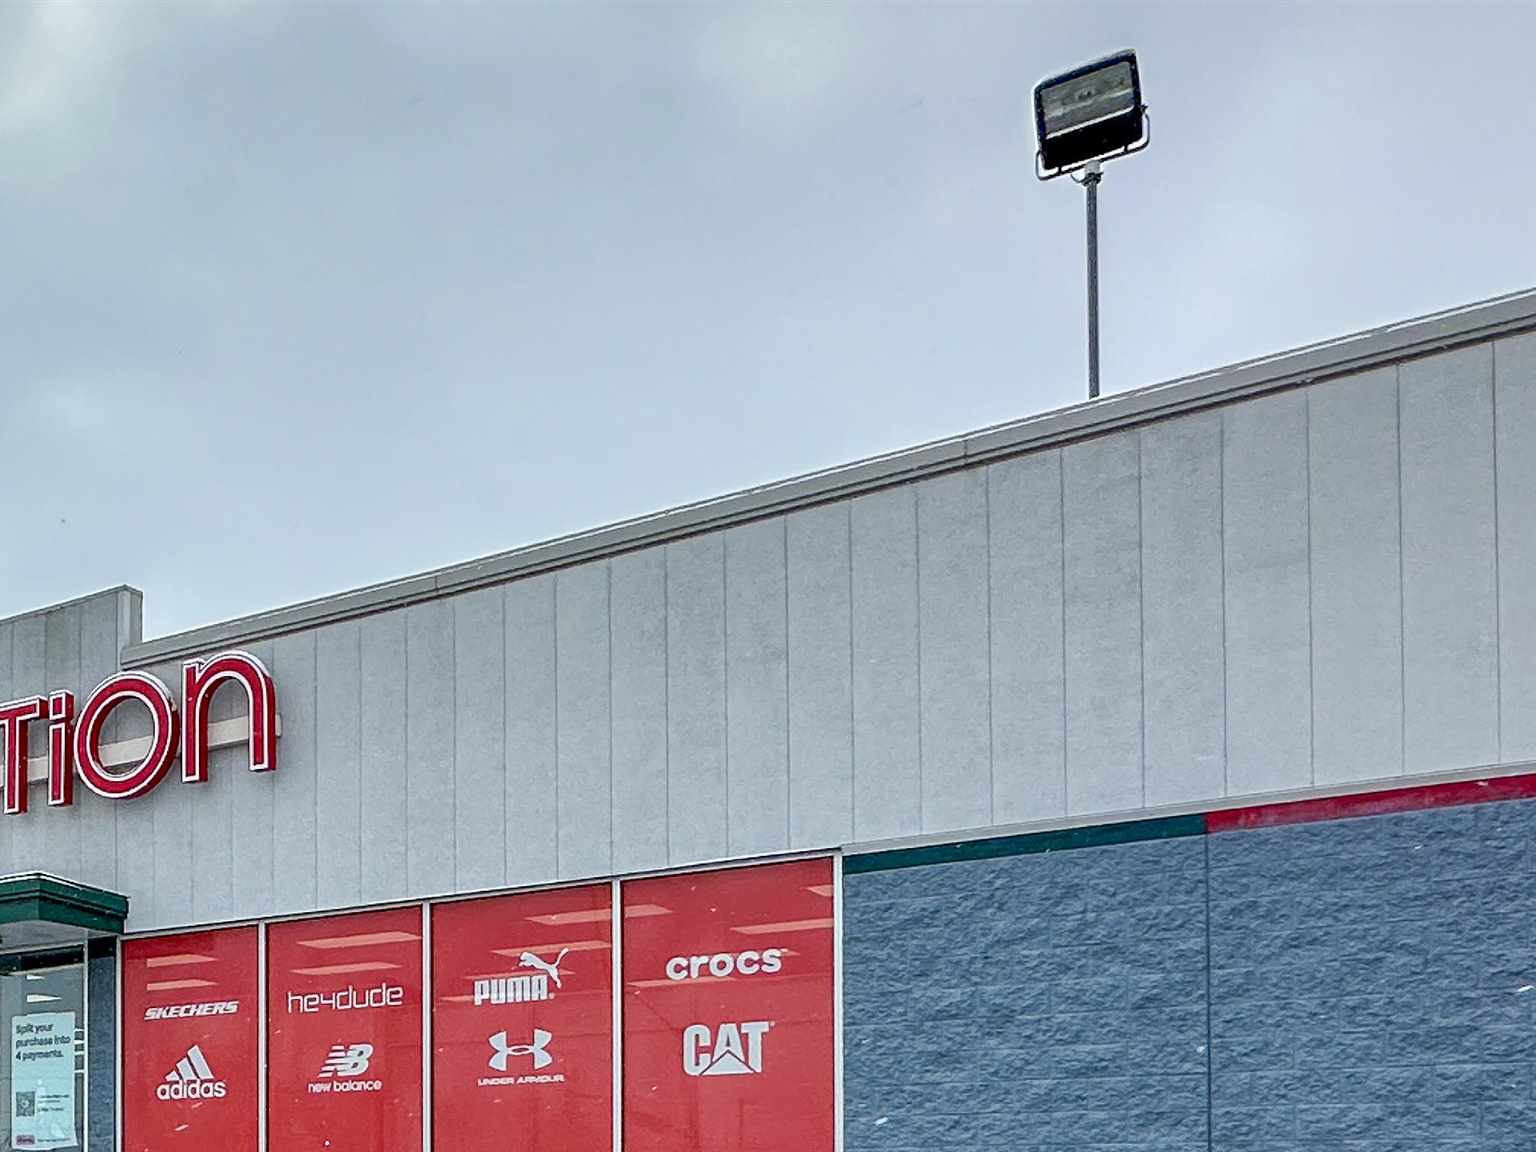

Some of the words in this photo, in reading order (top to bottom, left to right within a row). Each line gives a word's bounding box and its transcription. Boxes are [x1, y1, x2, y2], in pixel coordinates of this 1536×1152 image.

[666, 949, 782, 980] crocs
[474, 975, 549, 1005] PUMA
[144, 1000, 240, 1021] SKECHERS
[683, 1021, 770, 1076] CAT
[156, 1078, 227, 1100] adidas
[308, 1082, 331, 1094] new
[333, 1080, 382, 1093] balance
[478, 1077, 514, 1087] UNDER
[516, 1074, 565, 1085] ARMOUR
